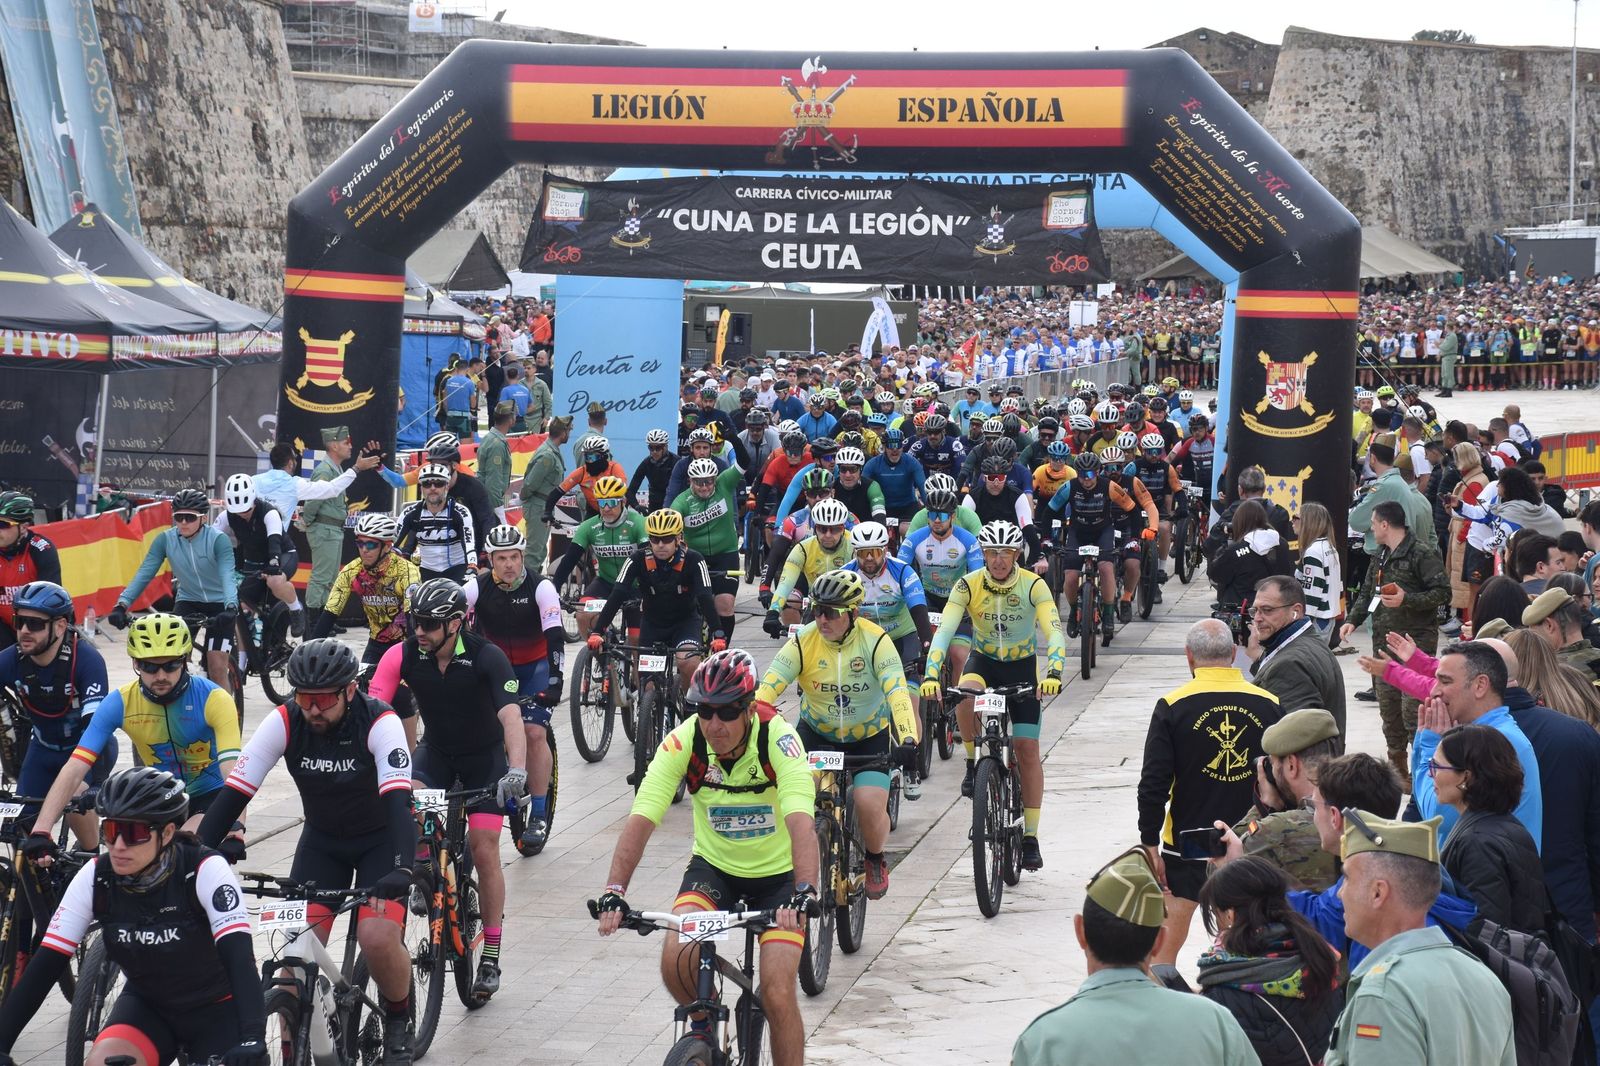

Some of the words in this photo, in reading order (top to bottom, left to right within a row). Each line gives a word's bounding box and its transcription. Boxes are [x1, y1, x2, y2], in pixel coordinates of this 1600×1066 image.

[592, 89, 707, 120] LEGIÓN
[897, 91, 1064, 122] ESPAÑOLA
[328, 159, 379, 207] Espíritu
[379, 137, 395, 161] del
[393, 89, 454, 146] Legionario
[1180, 96, 1232, 150] Espíritu
[1230, 149, 1248, 164] de
[1244, 161, 1258, 175] la
[1257, 169, 1305, 221] Muerte
[736, 187, 792, 200] CARRERA
[796, 186, 893, 200] CÍVICO-MILITAR
[764, 212, 797, 234] DE
[806, 213, 840, 234] LA
[1052, 216, 1075, 224] Shop
[761, 242, 862, 270] CEUTA
[566, 350, 634, 378] Ceuta
[640, 359, 662, 373] es
[568, 390, 662, 414] Dporte
[690, 510, 722, 526] NATURE
[1235, 546, 1250, 558] HH
[978, 611, 1023, 621] VEROSA
[650, 660, 664, 668] 377
[812, 681, 870, 693] VEROSA
[988, 699, 1003, 708] 149
[828, 705, 857, 718] Cycle
[1193, 711, 1210, 730] TERCIO
[822, 757, 840, 765] 309
[1228, 770, 1252, 782] LEGIÓN
[738, 814, 766, 826] 523
[278, 908, 304, 920] 466
[698, 920, 724, 932] 523
